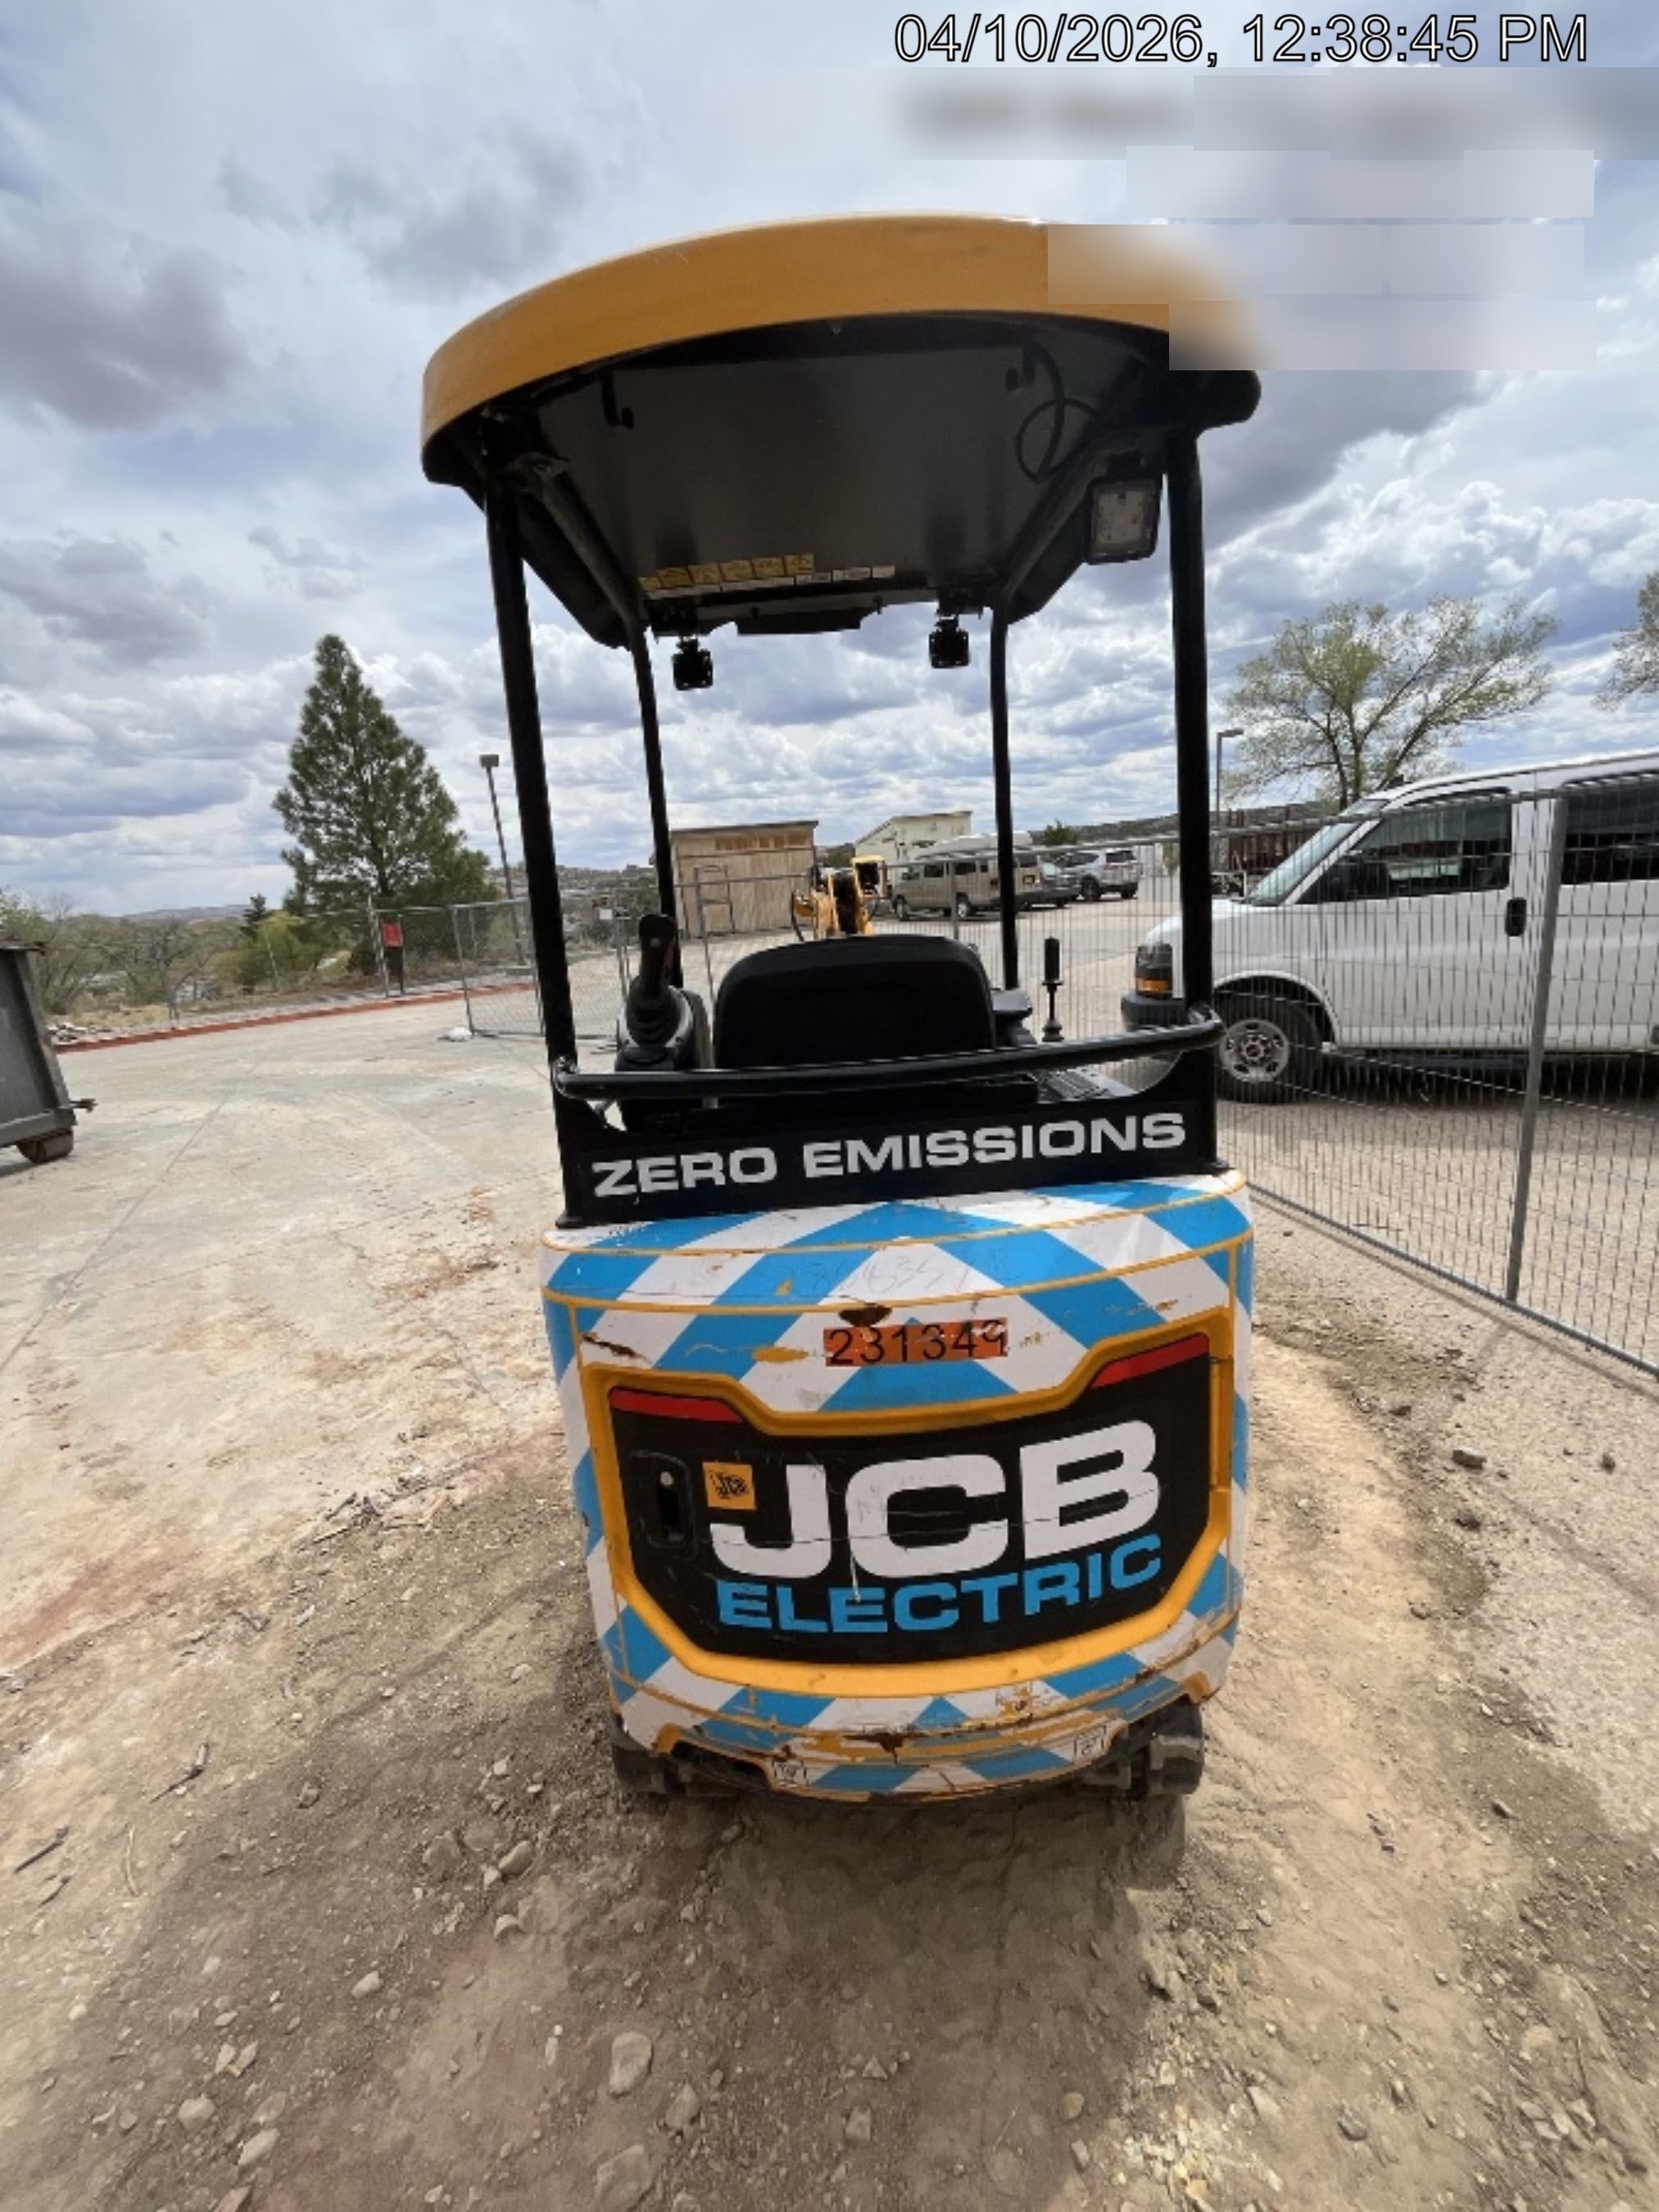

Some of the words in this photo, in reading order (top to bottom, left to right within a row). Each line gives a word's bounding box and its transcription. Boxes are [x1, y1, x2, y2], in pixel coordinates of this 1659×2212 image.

[592, 1148, 777, 1197] ZERO
[803, 1113, 1185, 1178] EMISSIONS
[828, 1319, 1007, 1366] 231349
[709, 1421, 1160, 1578] JCB
[716, 1534, 1162, 1633] ELECTRIC
